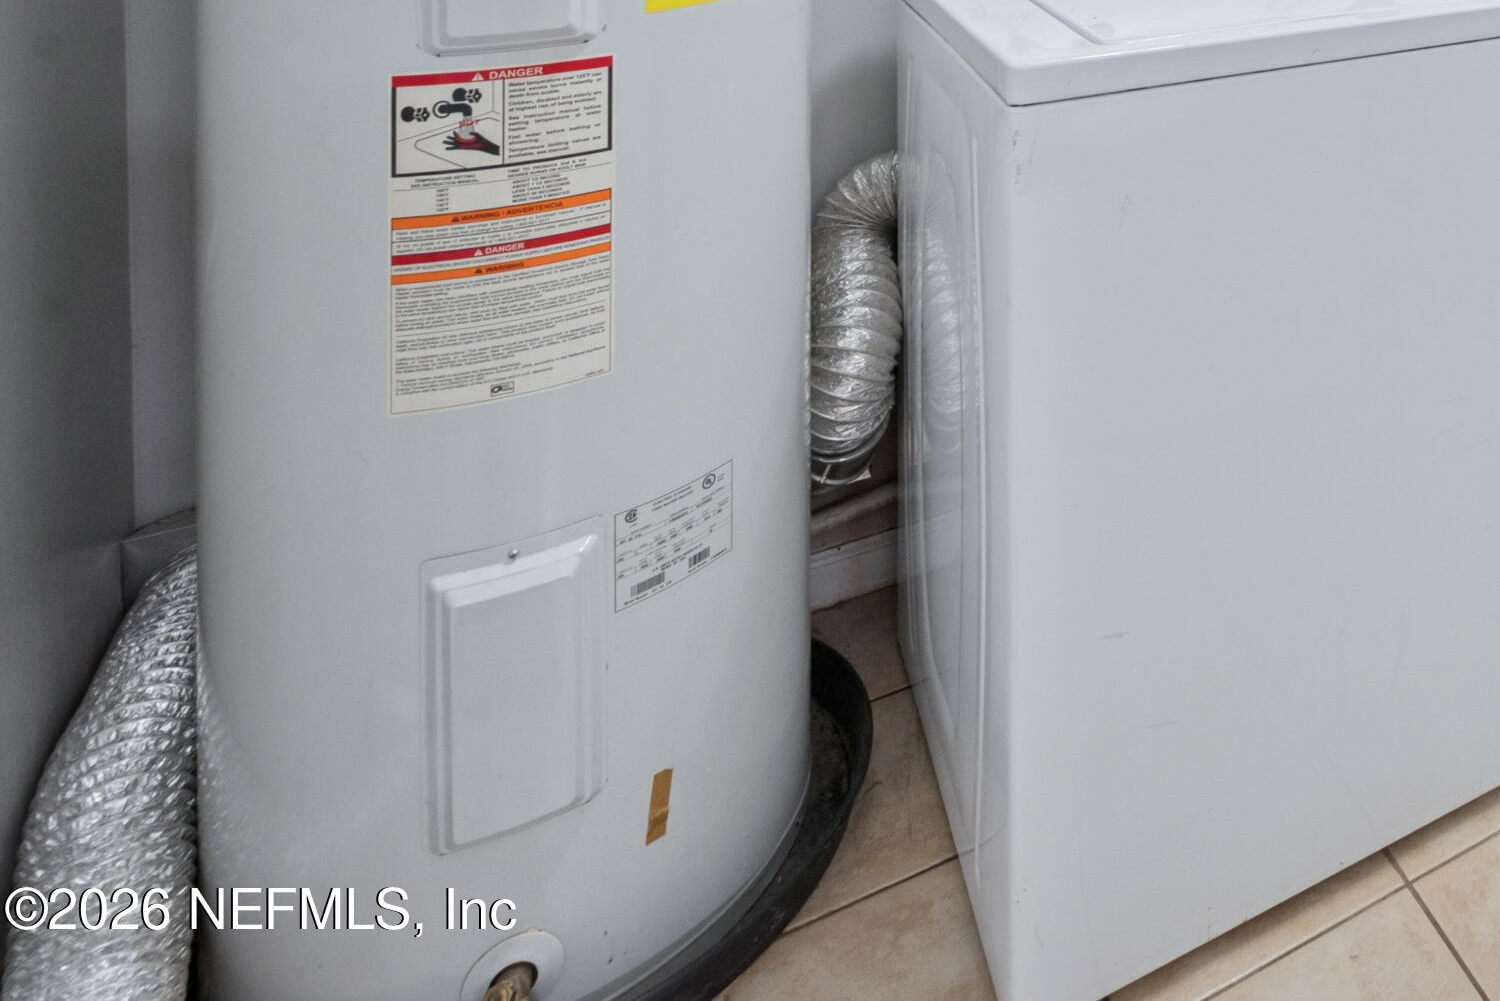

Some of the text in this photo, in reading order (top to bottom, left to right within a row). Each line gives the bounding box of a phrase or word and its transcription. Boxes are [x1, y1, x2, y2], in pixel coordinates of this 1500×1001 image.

[489, 66, 544, 80] DANGER
[461, 210, 501, 221] WARNING
[485, 242, 525, 255] DANGER
[485, 262, 524, 273] WARNING
